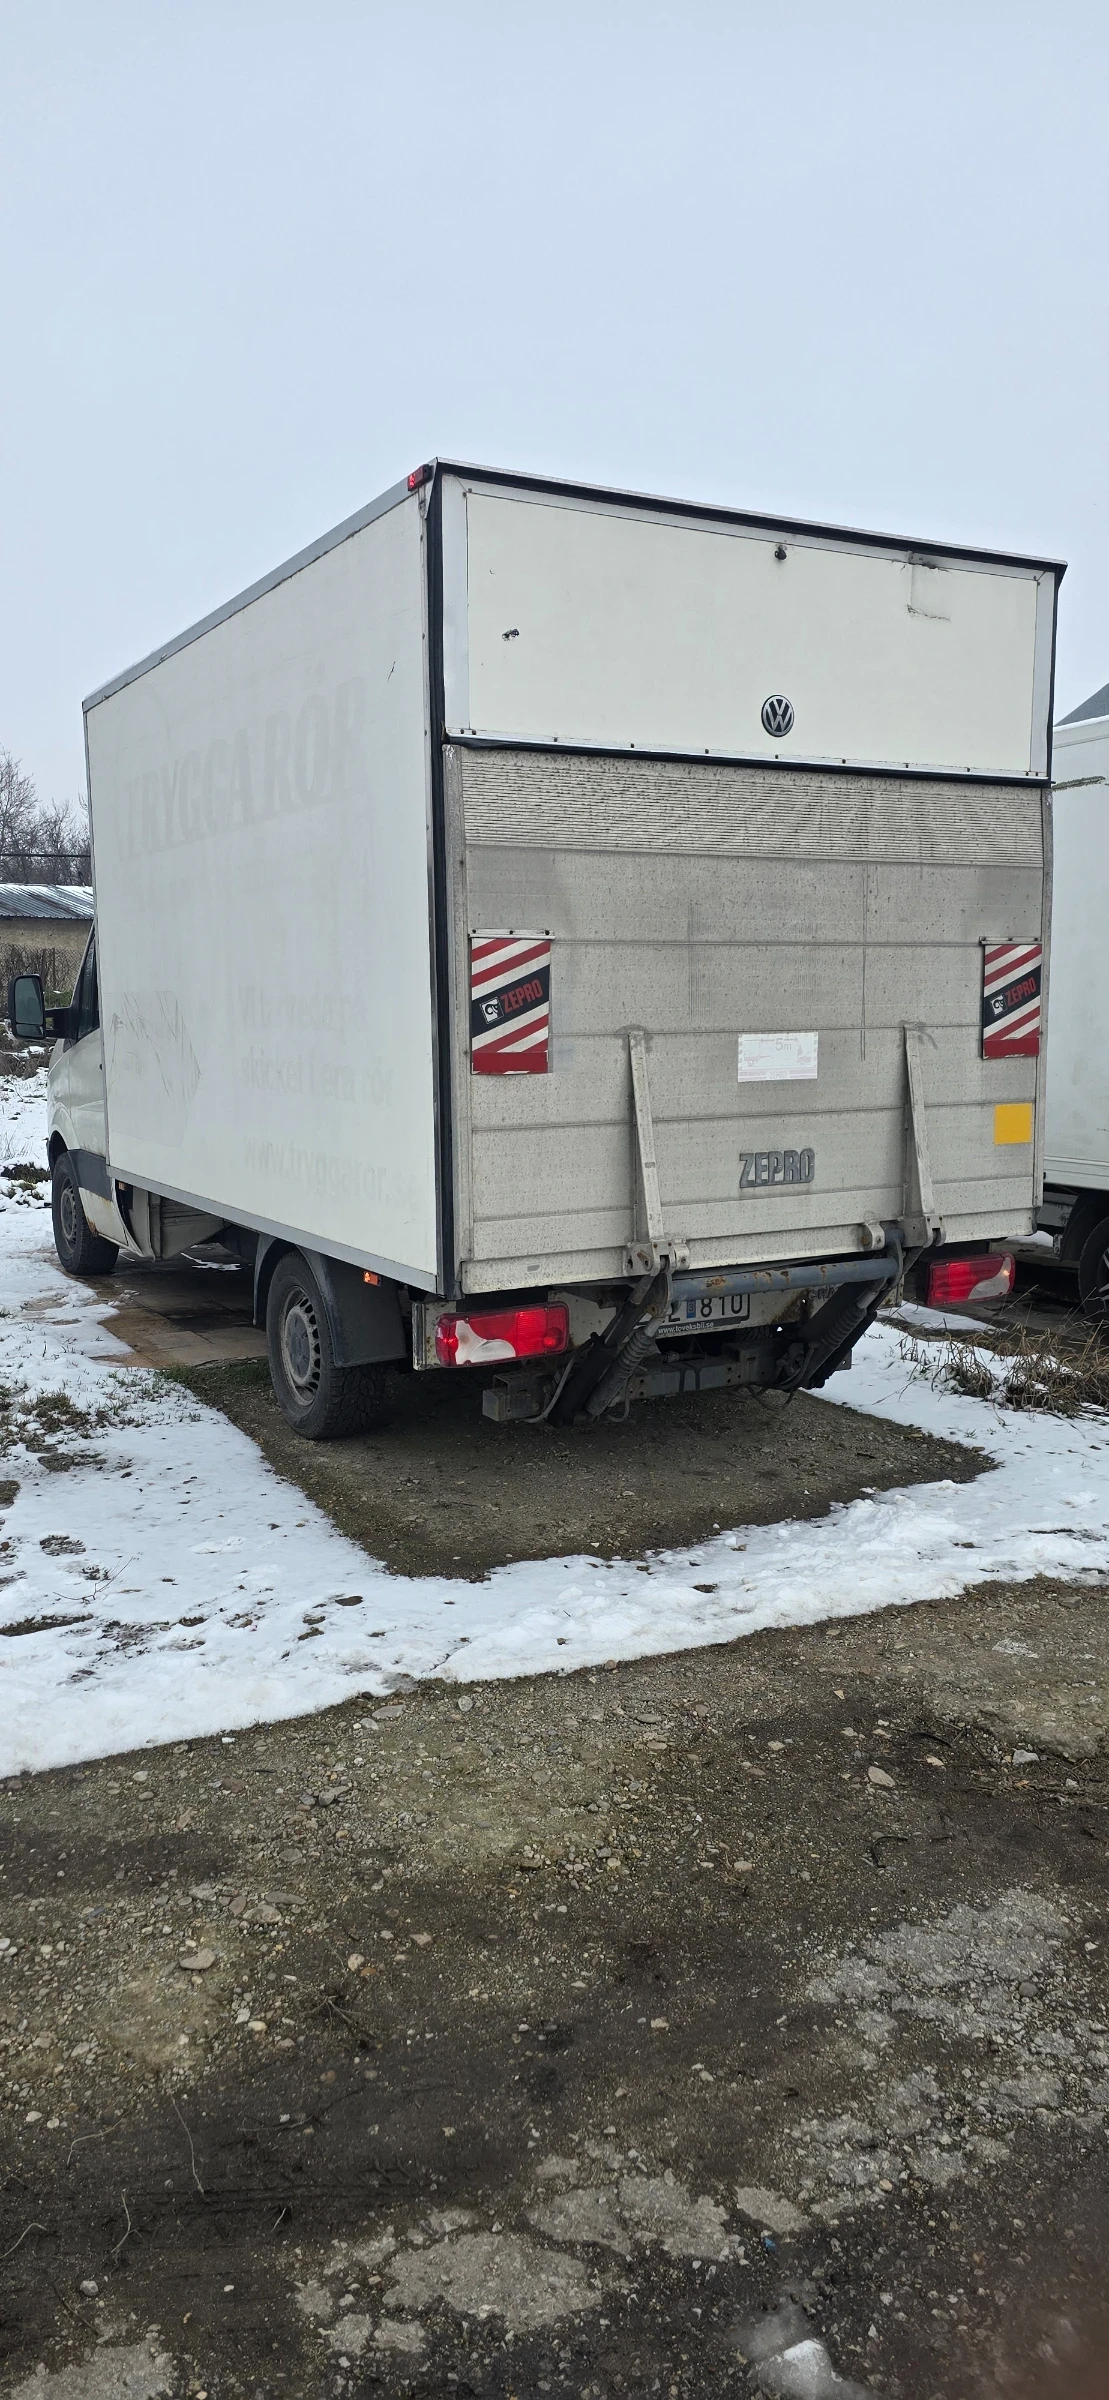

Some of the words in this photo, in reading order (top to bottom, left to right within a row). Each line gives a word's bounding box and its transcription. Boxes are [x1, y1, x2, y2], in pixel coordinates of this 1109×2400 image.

[761, 695, 795, 738] VW
[501, 979, 543, 1013] ZEPRO
[1005, 976, 1037, 1007] ZEPRO
[739, 1148, 815, 1188] ZEPRO
[700, 1294, 742, 1318] 810
